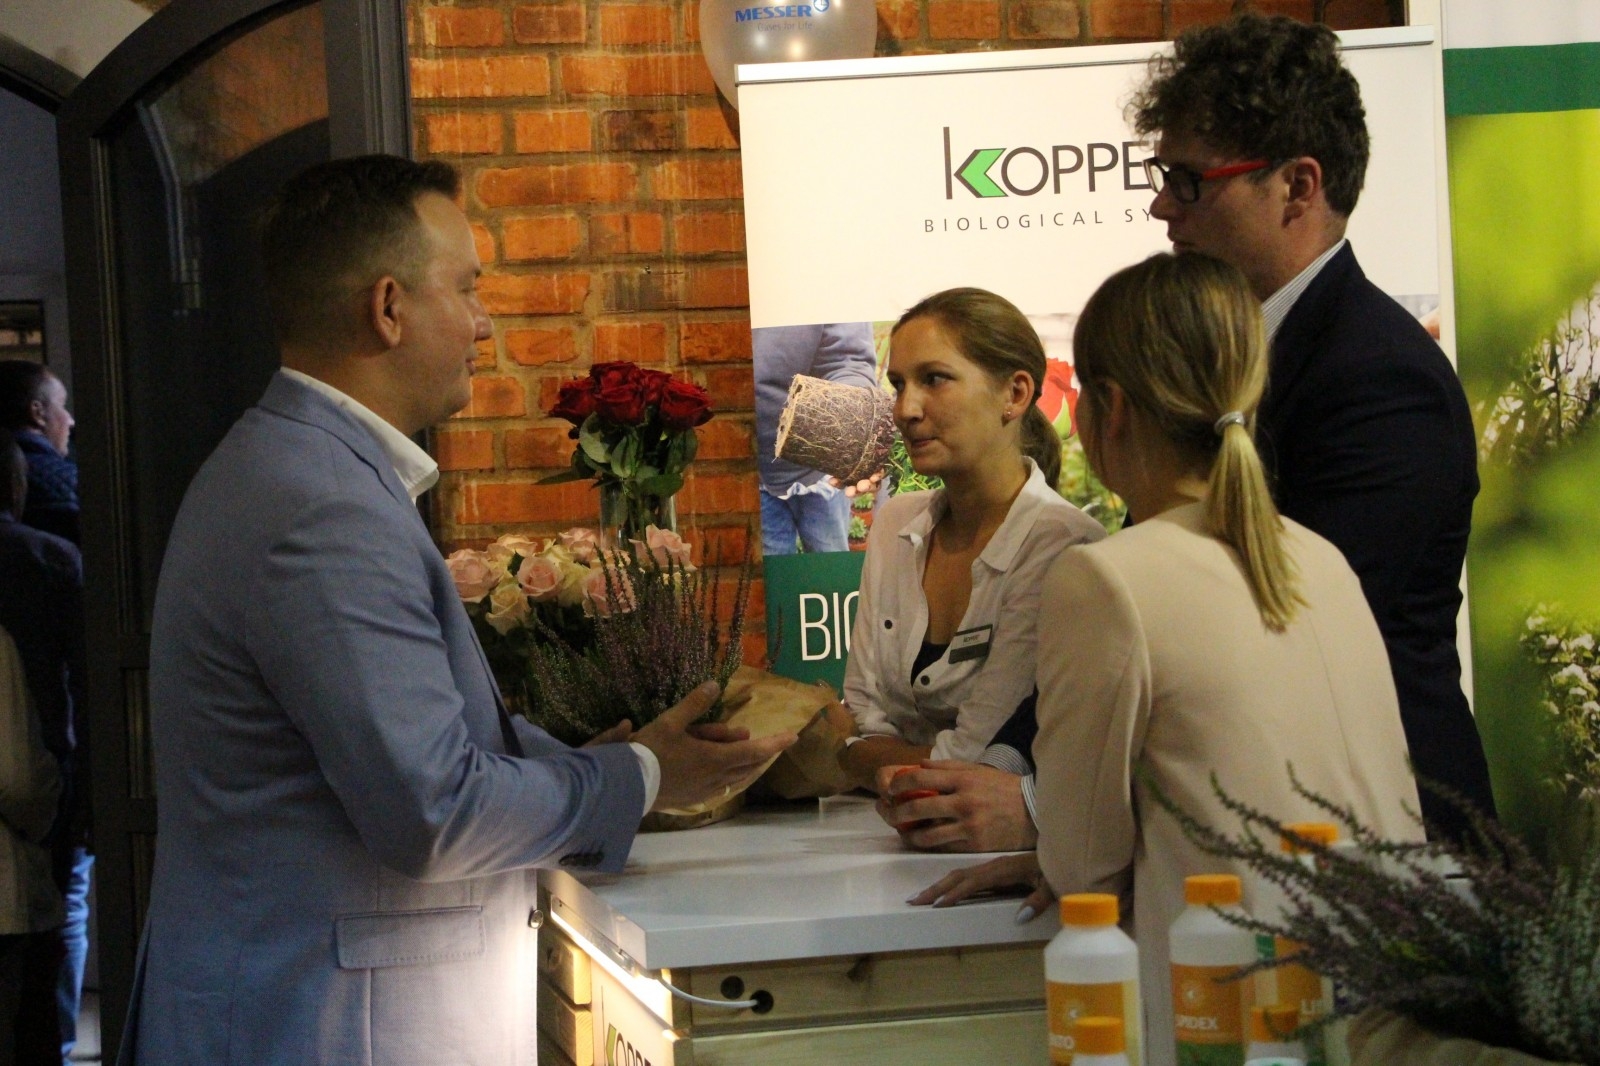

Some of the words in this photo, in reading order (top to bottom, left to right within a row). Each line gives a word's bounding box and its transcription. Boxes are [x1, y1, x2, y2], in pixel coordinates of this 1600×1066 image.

[735, 5, 812, 22] MESSER
[757, 22, 781, 32] Gases
[784, 21, 795, 31] for
[798, 20, 813, 30] Life
[943, 126, 1161, 200] KOPPE
[924, 210, 1103, 233] BIOLOGICAL
